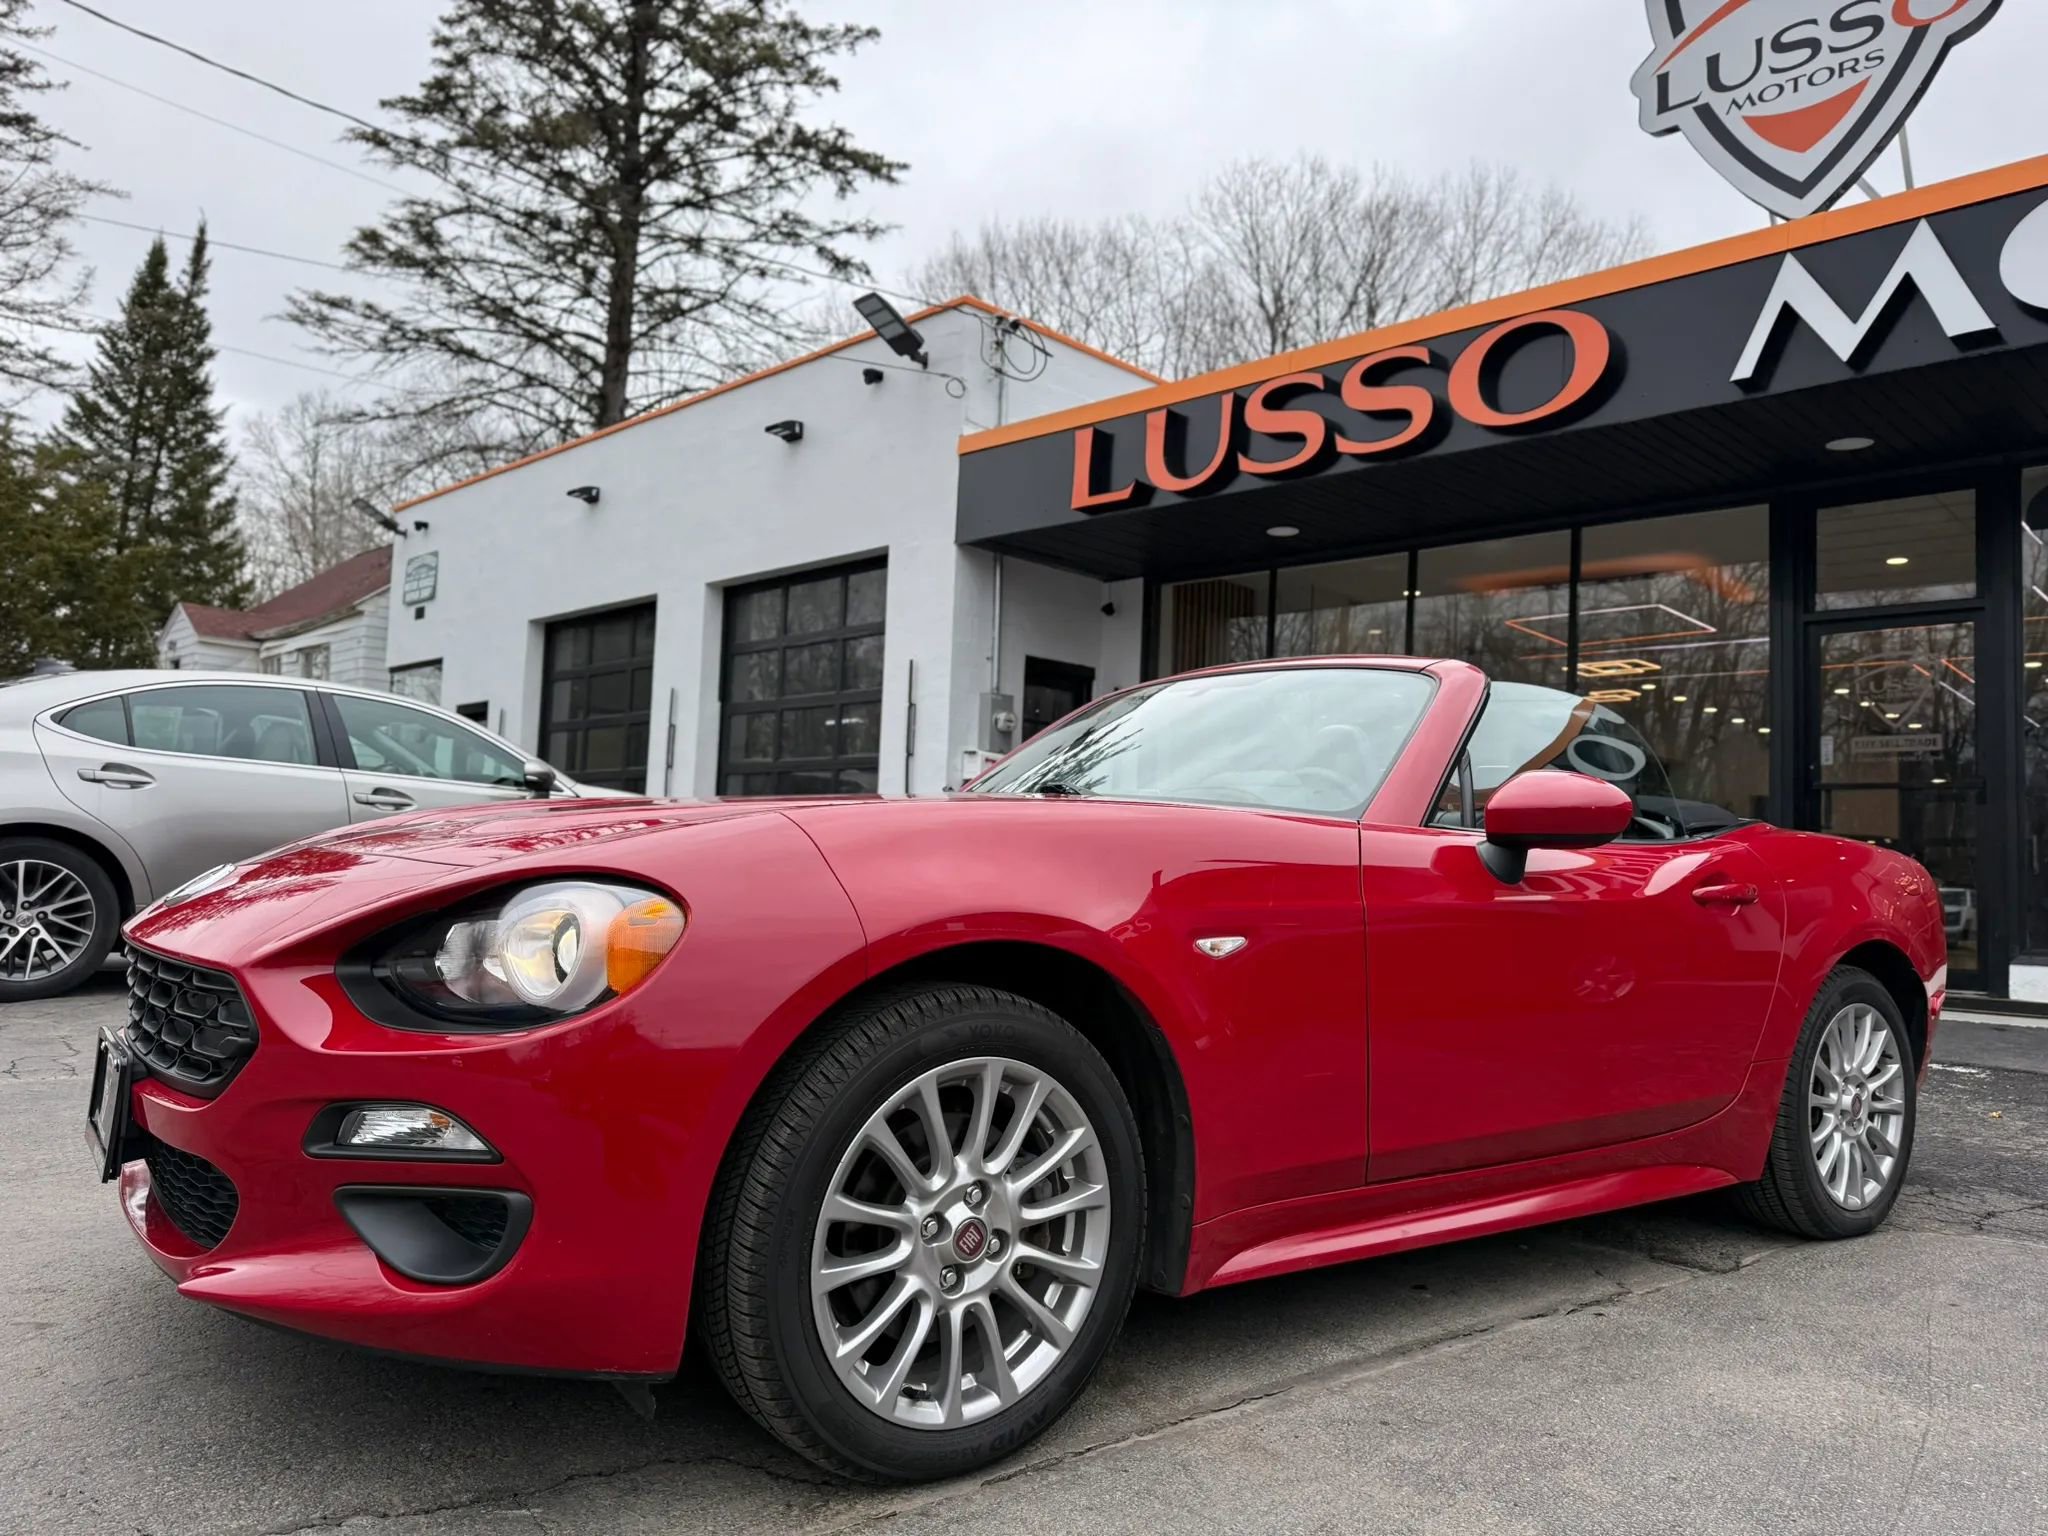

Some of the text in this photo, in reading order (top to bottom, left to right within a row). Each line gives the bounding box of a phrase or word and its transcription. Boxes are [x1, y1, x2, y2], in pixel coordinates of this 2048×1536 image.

[1725, 48, 1885, 116] MOTORS
[1071, 309, 1610, 511] LUSSO
[959, 1225, 981, 1254] FIAT
